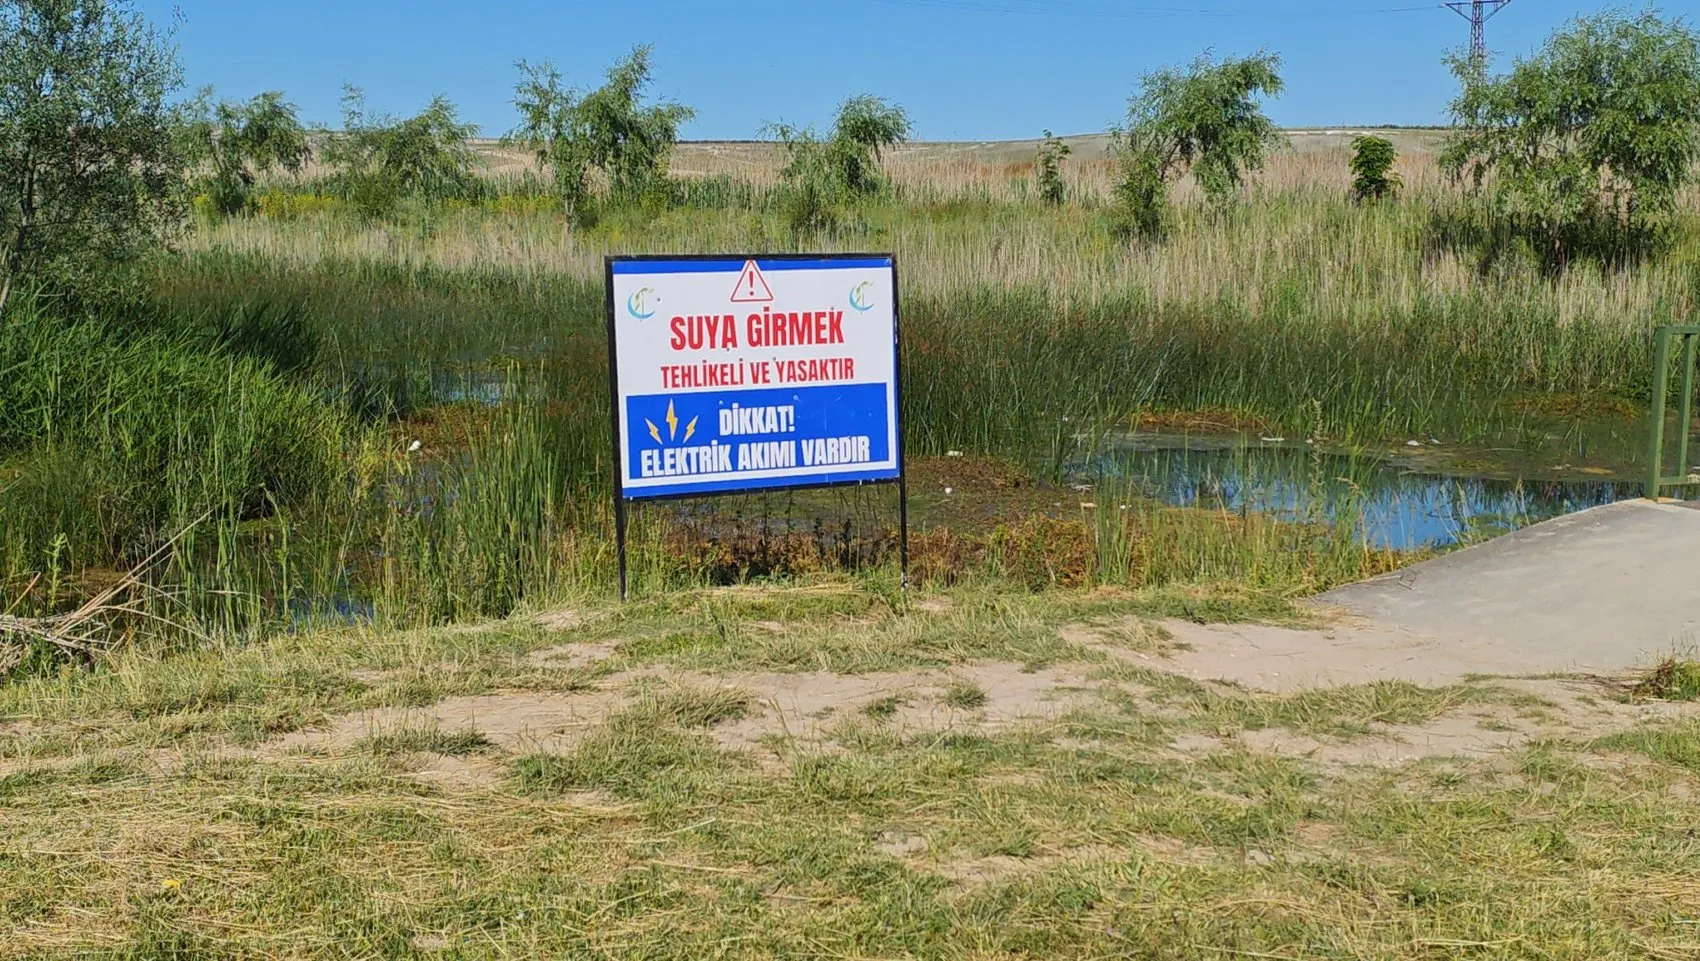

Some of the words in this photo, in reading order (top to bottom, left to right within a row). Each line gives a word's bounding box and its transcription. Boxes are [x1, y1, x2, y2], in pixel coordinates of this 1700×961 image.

[669, 314, 738, 351] SUYA
[746, 306, 844, 347] GİRMEK
[661, 358, 744, 389] TEHLİKELİ
[750, 361, 770, 384] VE
[775, 357, 855, 382] YASAKTIR
[719, 402, 795, 435] DİKKAT!
[641, 440, 732, 477] ELEKTRİK
[738, 440, 796, 470] AKIMI
[801, 435, 870, 466] VARDIR
